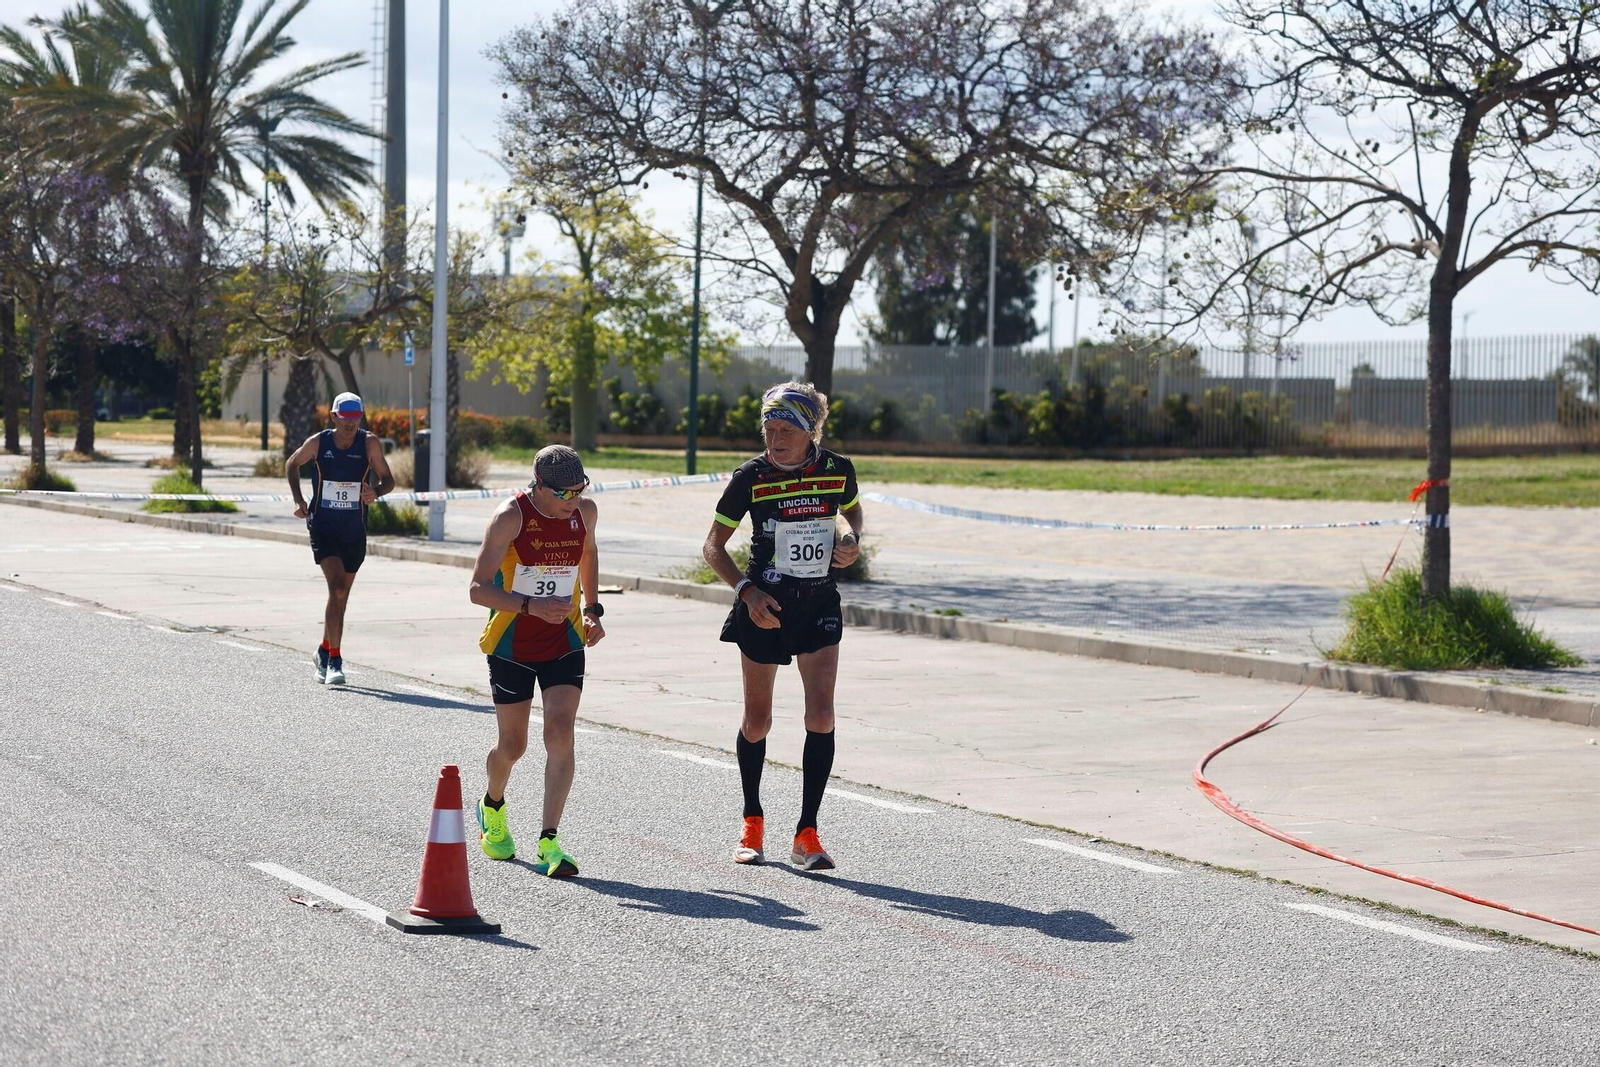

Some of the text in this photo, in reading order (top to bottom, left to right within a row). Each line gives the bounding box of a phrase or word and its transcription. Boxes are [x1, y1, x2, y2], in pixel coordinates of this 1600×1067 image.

[754, 480, 845, 499] DEVIL BIKE TEAM
[336, 491, 348, 500] 18
[778, 498, 820, 509] LINCOLN
[788, 506, 825, 515] ELECTRIC
[544, 552, 569, 560] VINO
[790, 543, 824, 561] 306
[534, 581, 557, 596] 39
